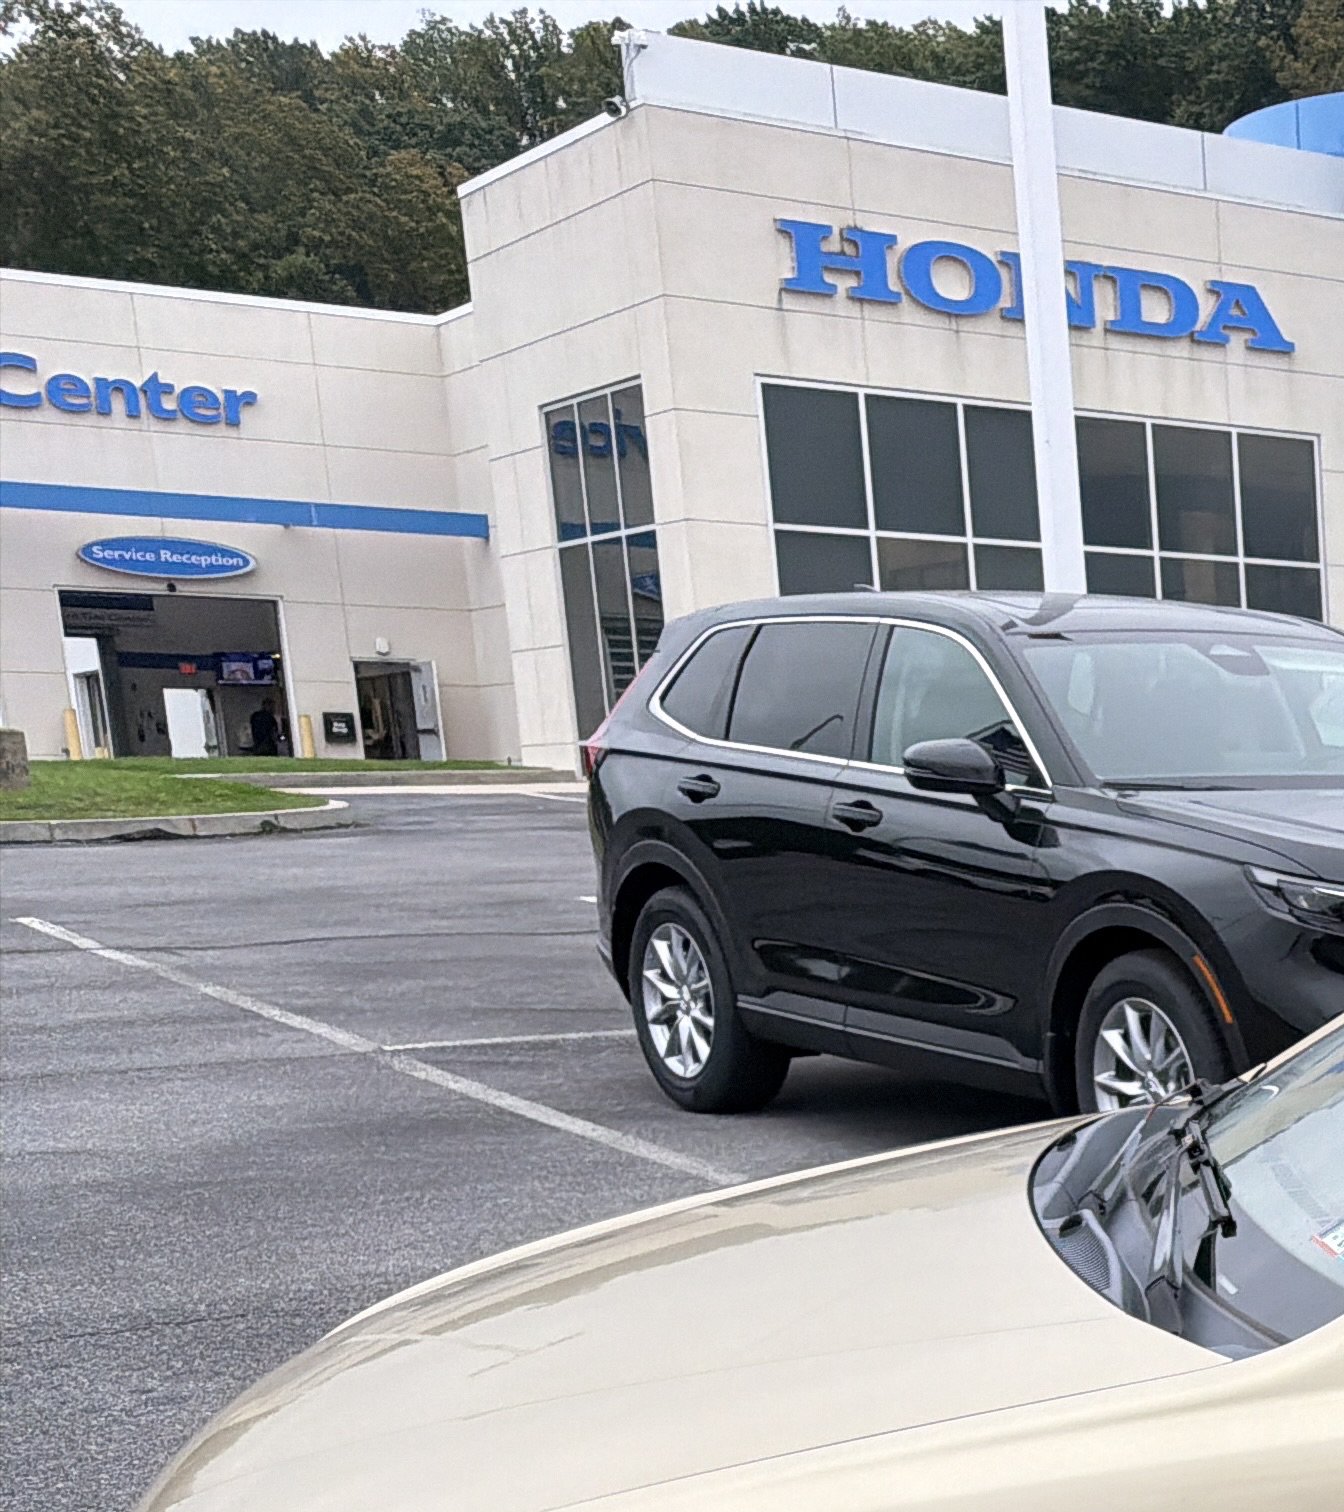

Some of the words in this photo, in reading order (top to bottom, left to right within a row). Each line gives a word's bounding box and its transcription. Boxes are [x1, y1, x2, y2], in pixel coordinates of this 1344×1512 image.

[774, 218, 1295, 353] HONDA
[0, 351, 258, 427] Center
[91, 546, 155, 562] Service
[159, 549, 244, 568] Reception
